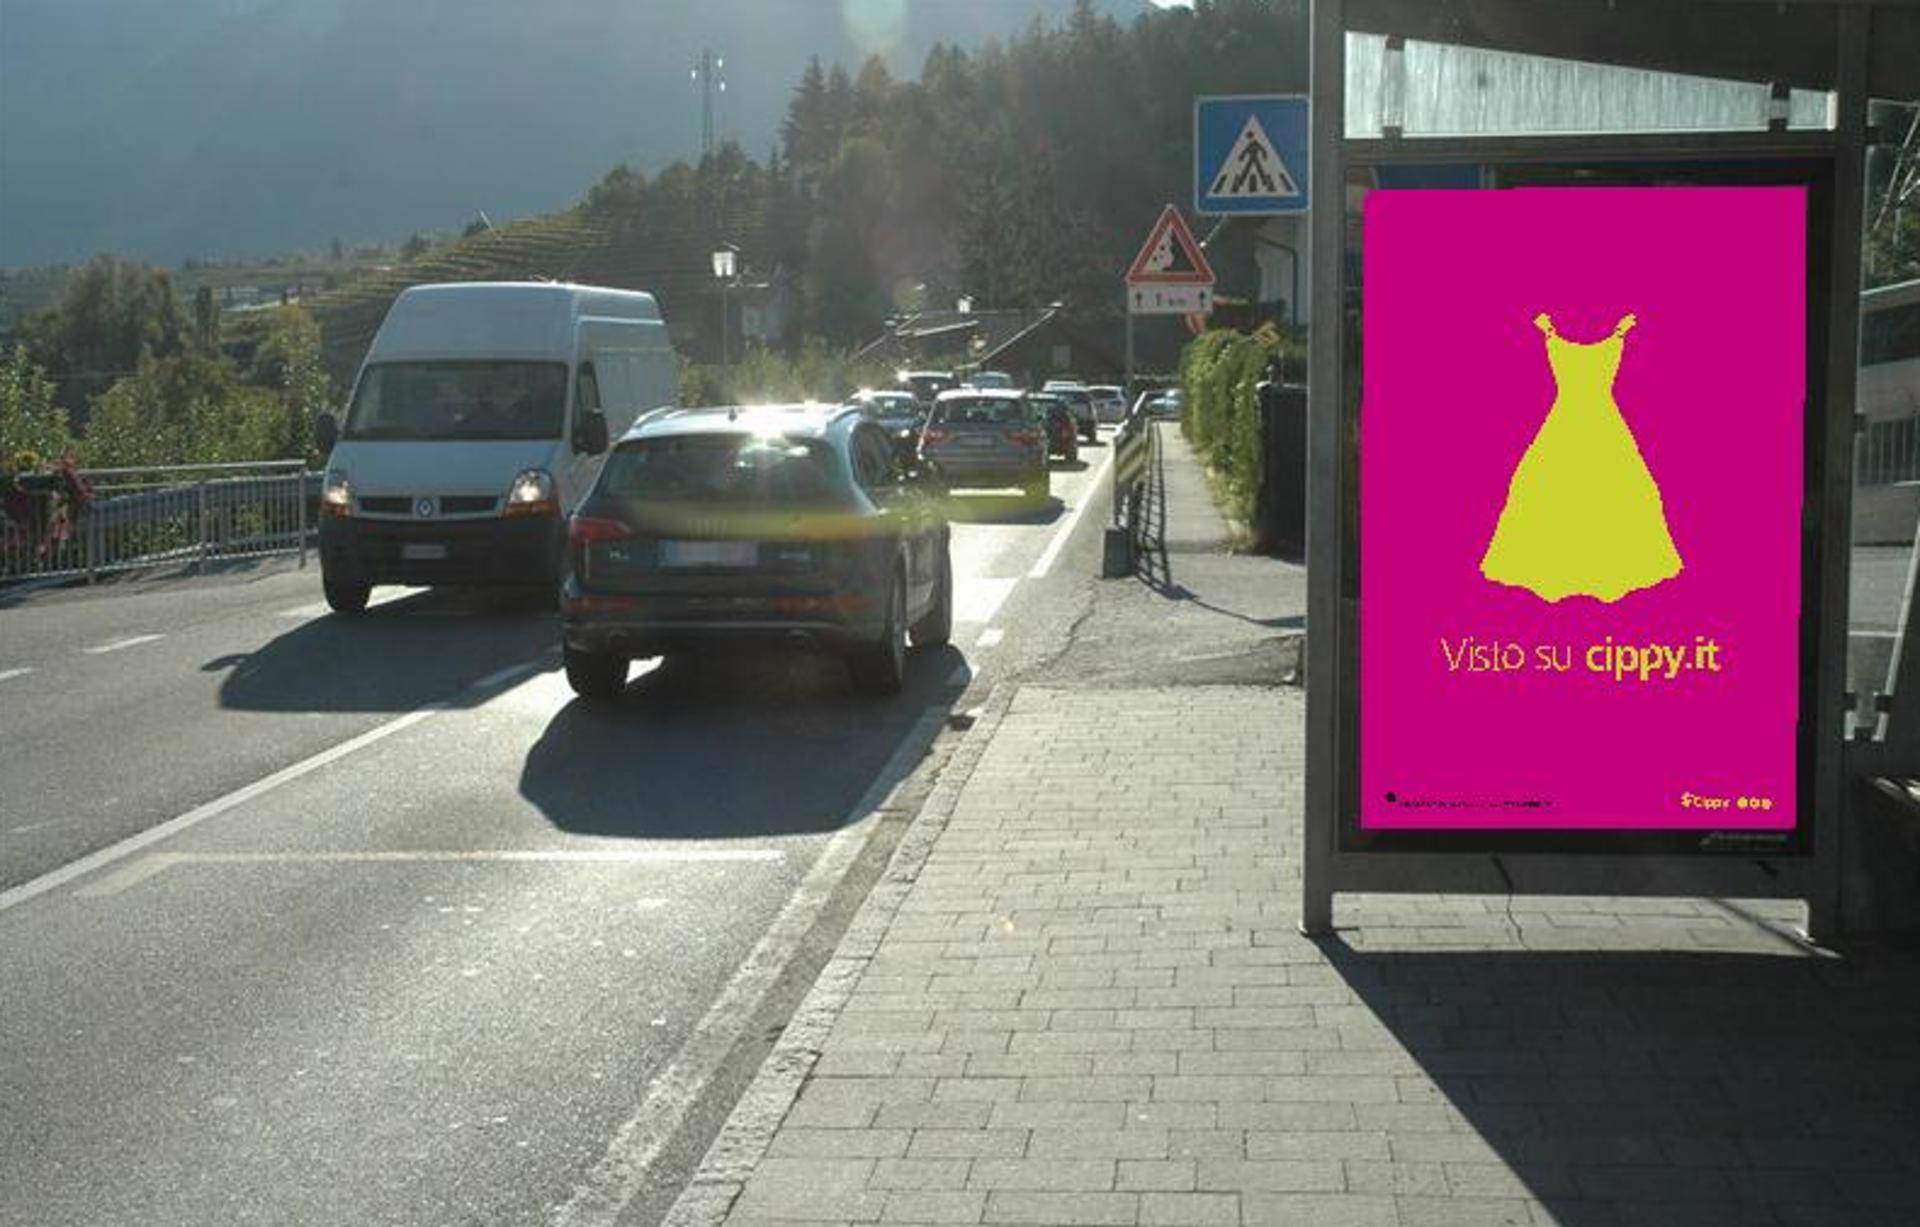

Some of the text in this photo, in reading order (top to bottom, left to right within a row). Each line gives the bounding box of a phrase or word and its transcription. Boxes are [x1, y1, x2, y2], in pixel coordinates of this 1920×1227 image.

[1440, 635, 1721, 682] Visto su cippy.it
